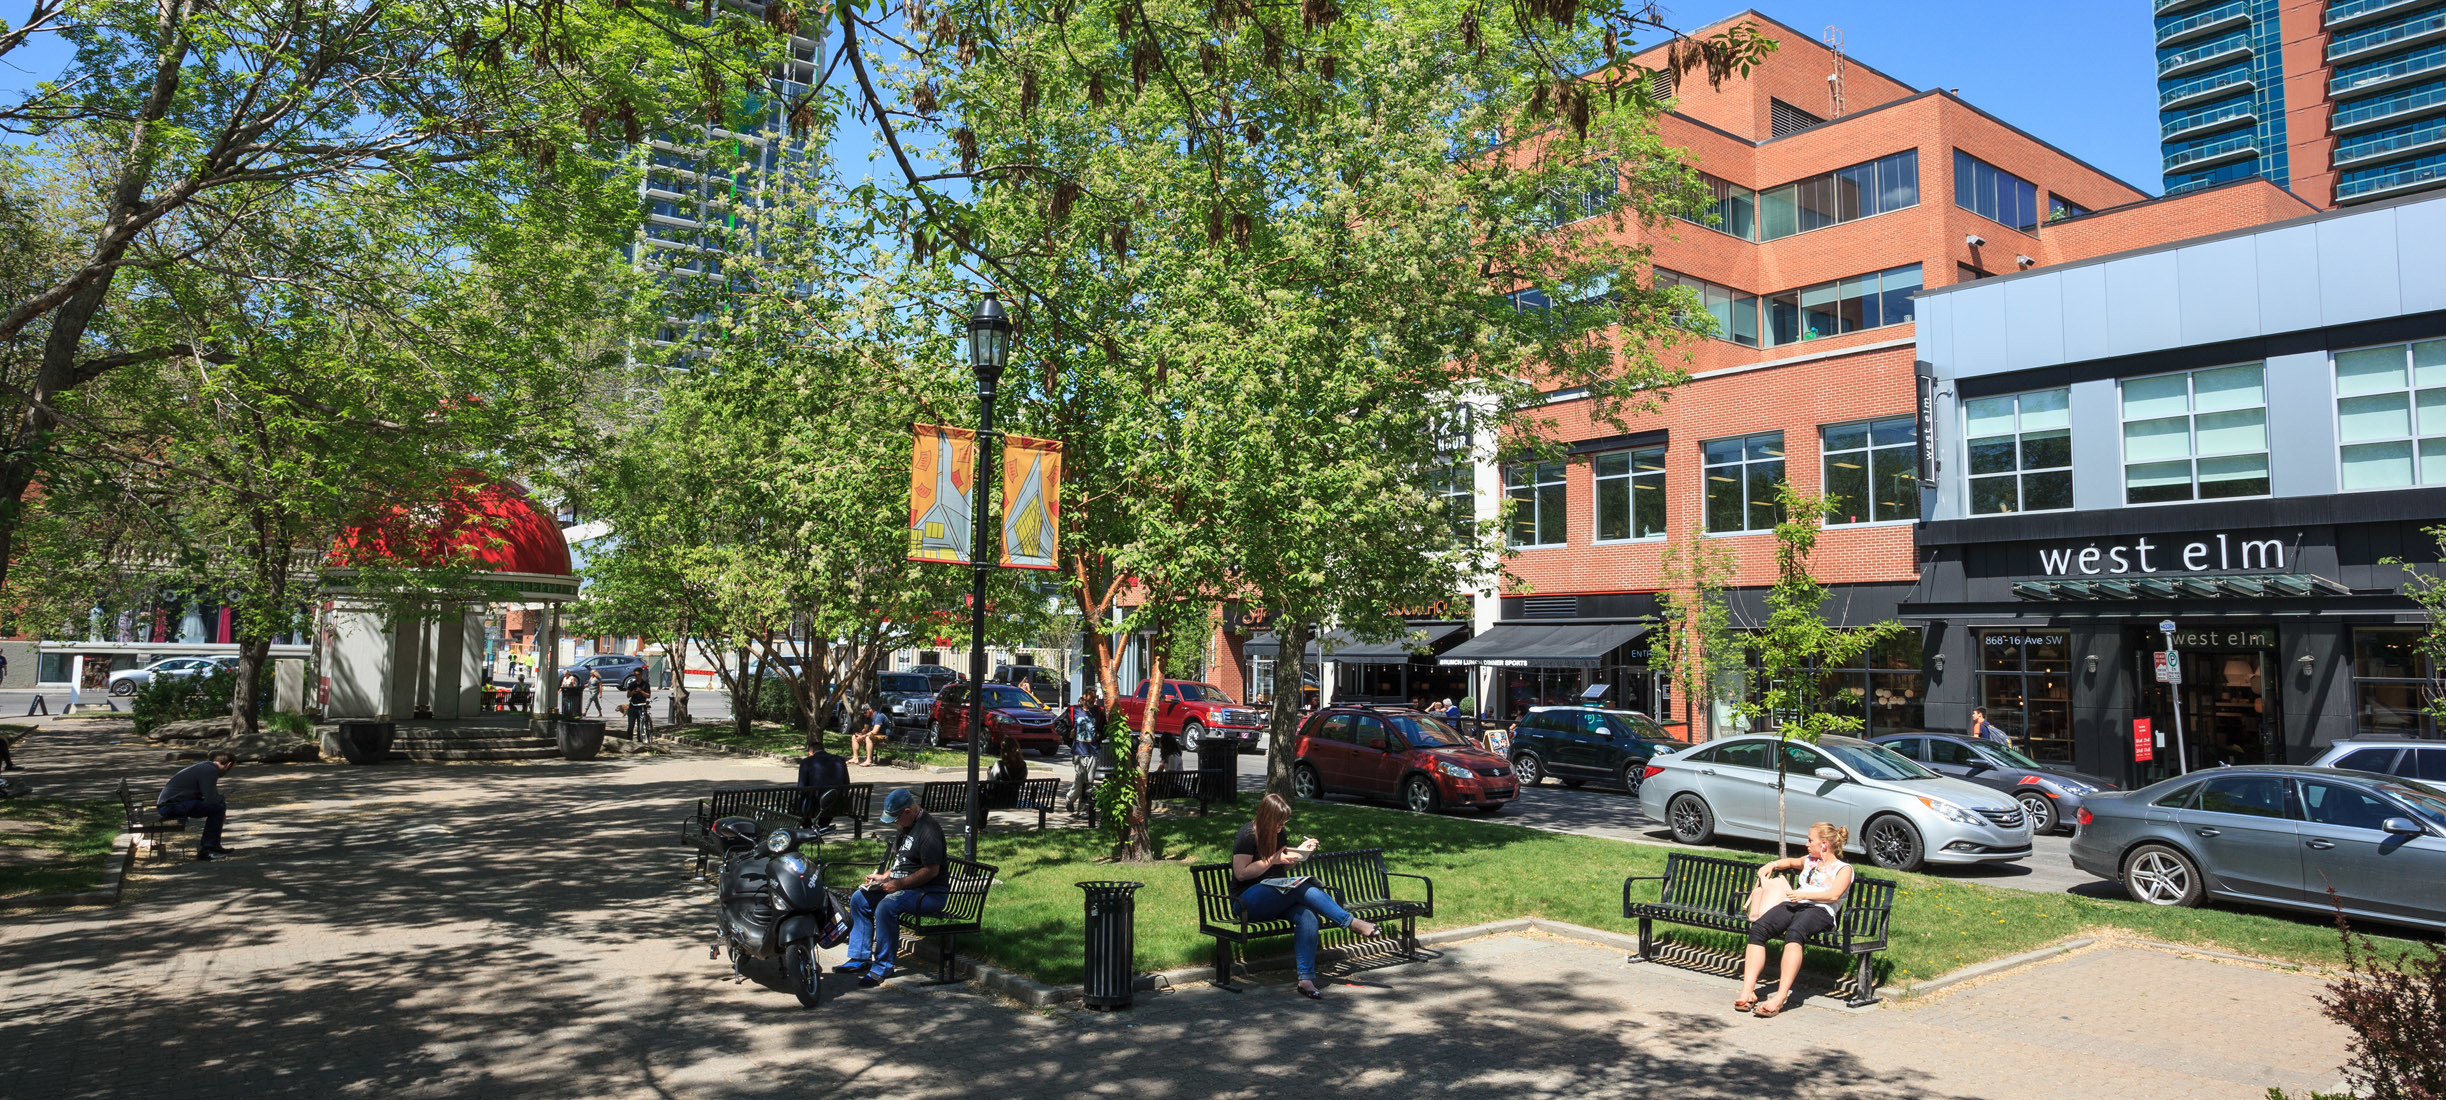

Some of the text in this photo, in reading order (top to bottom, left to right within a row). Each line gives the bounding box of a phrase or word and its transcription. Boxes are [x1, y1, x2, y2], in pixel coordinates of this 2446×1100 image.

[1438, 436, 1467, 452] HOUR
[2040, 534, 2284, 576] west elm
[1985, 635, 2063, 645] 868-16 Ave SW
[2172, 631, 2265, 646] west elm
